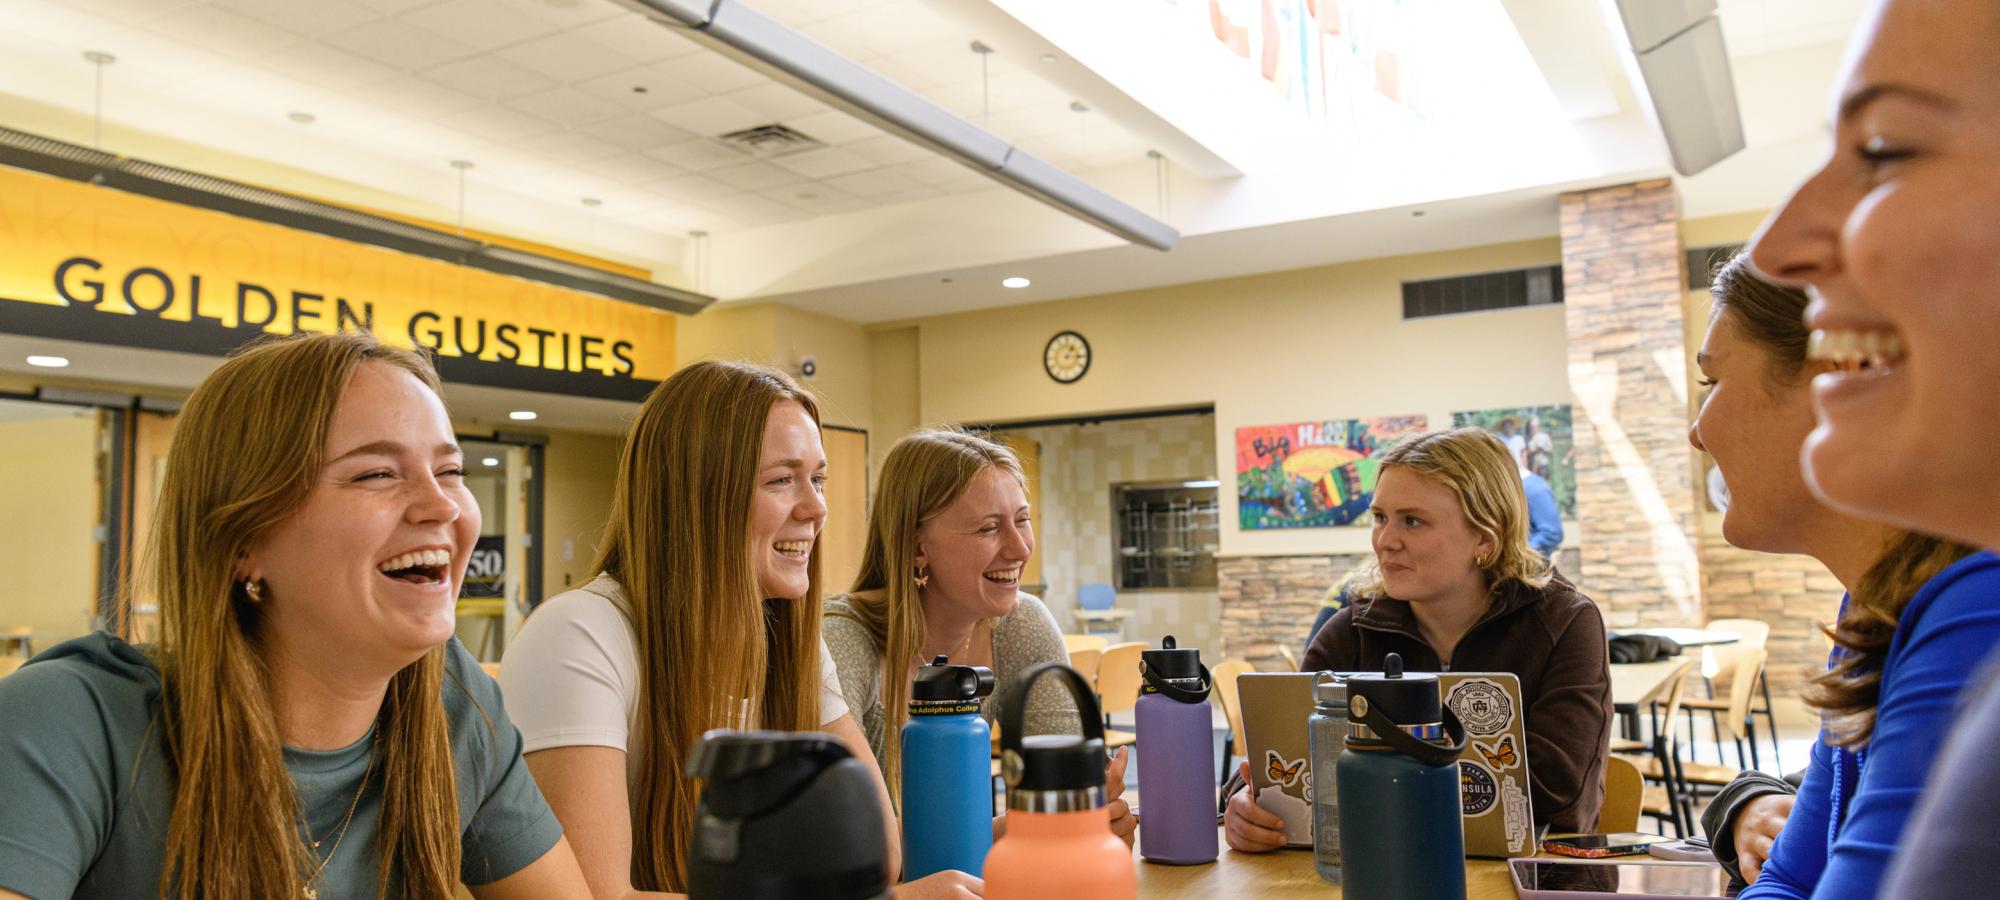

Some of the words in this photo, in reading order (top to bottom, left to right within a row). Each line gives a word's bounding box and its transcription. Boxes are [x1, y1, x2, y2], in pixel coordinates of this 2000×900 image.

[53, 256, 376, 336] GOLDEN
[407, 310, 636, 378] GUSTIES
[1252, 436, 1290, 459] Big
[1465, 685, 1493, 694] ADOLPHUS
[918, 706, 954, 714] Adolphus
[1467, 767, 1485, 780] PARK
[1462, 799, 1488, 810] ONSIN
